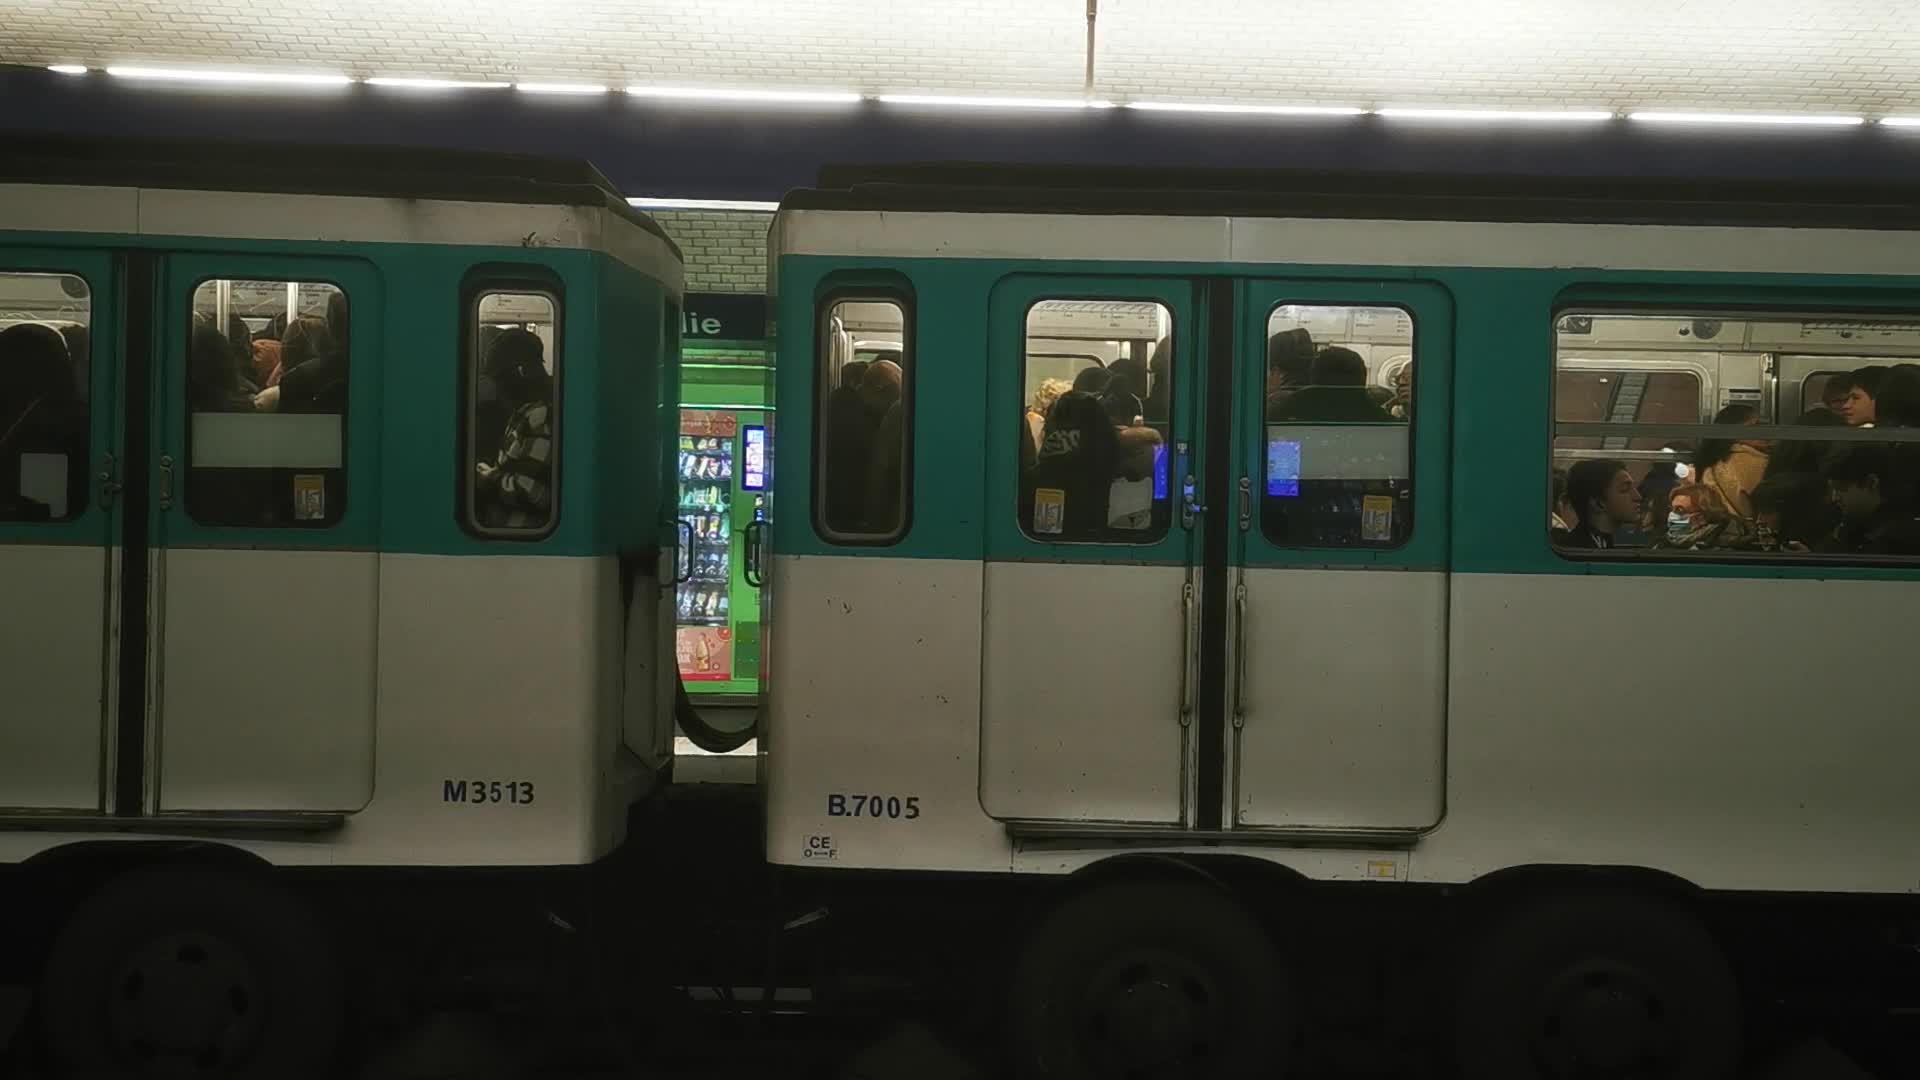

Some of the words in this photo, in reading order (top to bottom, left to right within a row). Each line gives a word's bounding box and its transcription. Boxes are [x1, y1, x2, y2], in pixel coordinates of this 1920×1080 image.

[443, 780, 535, 804] M3513
[828, 794, 921, 820] B.7005
[809, 836, 831, 849] CE
